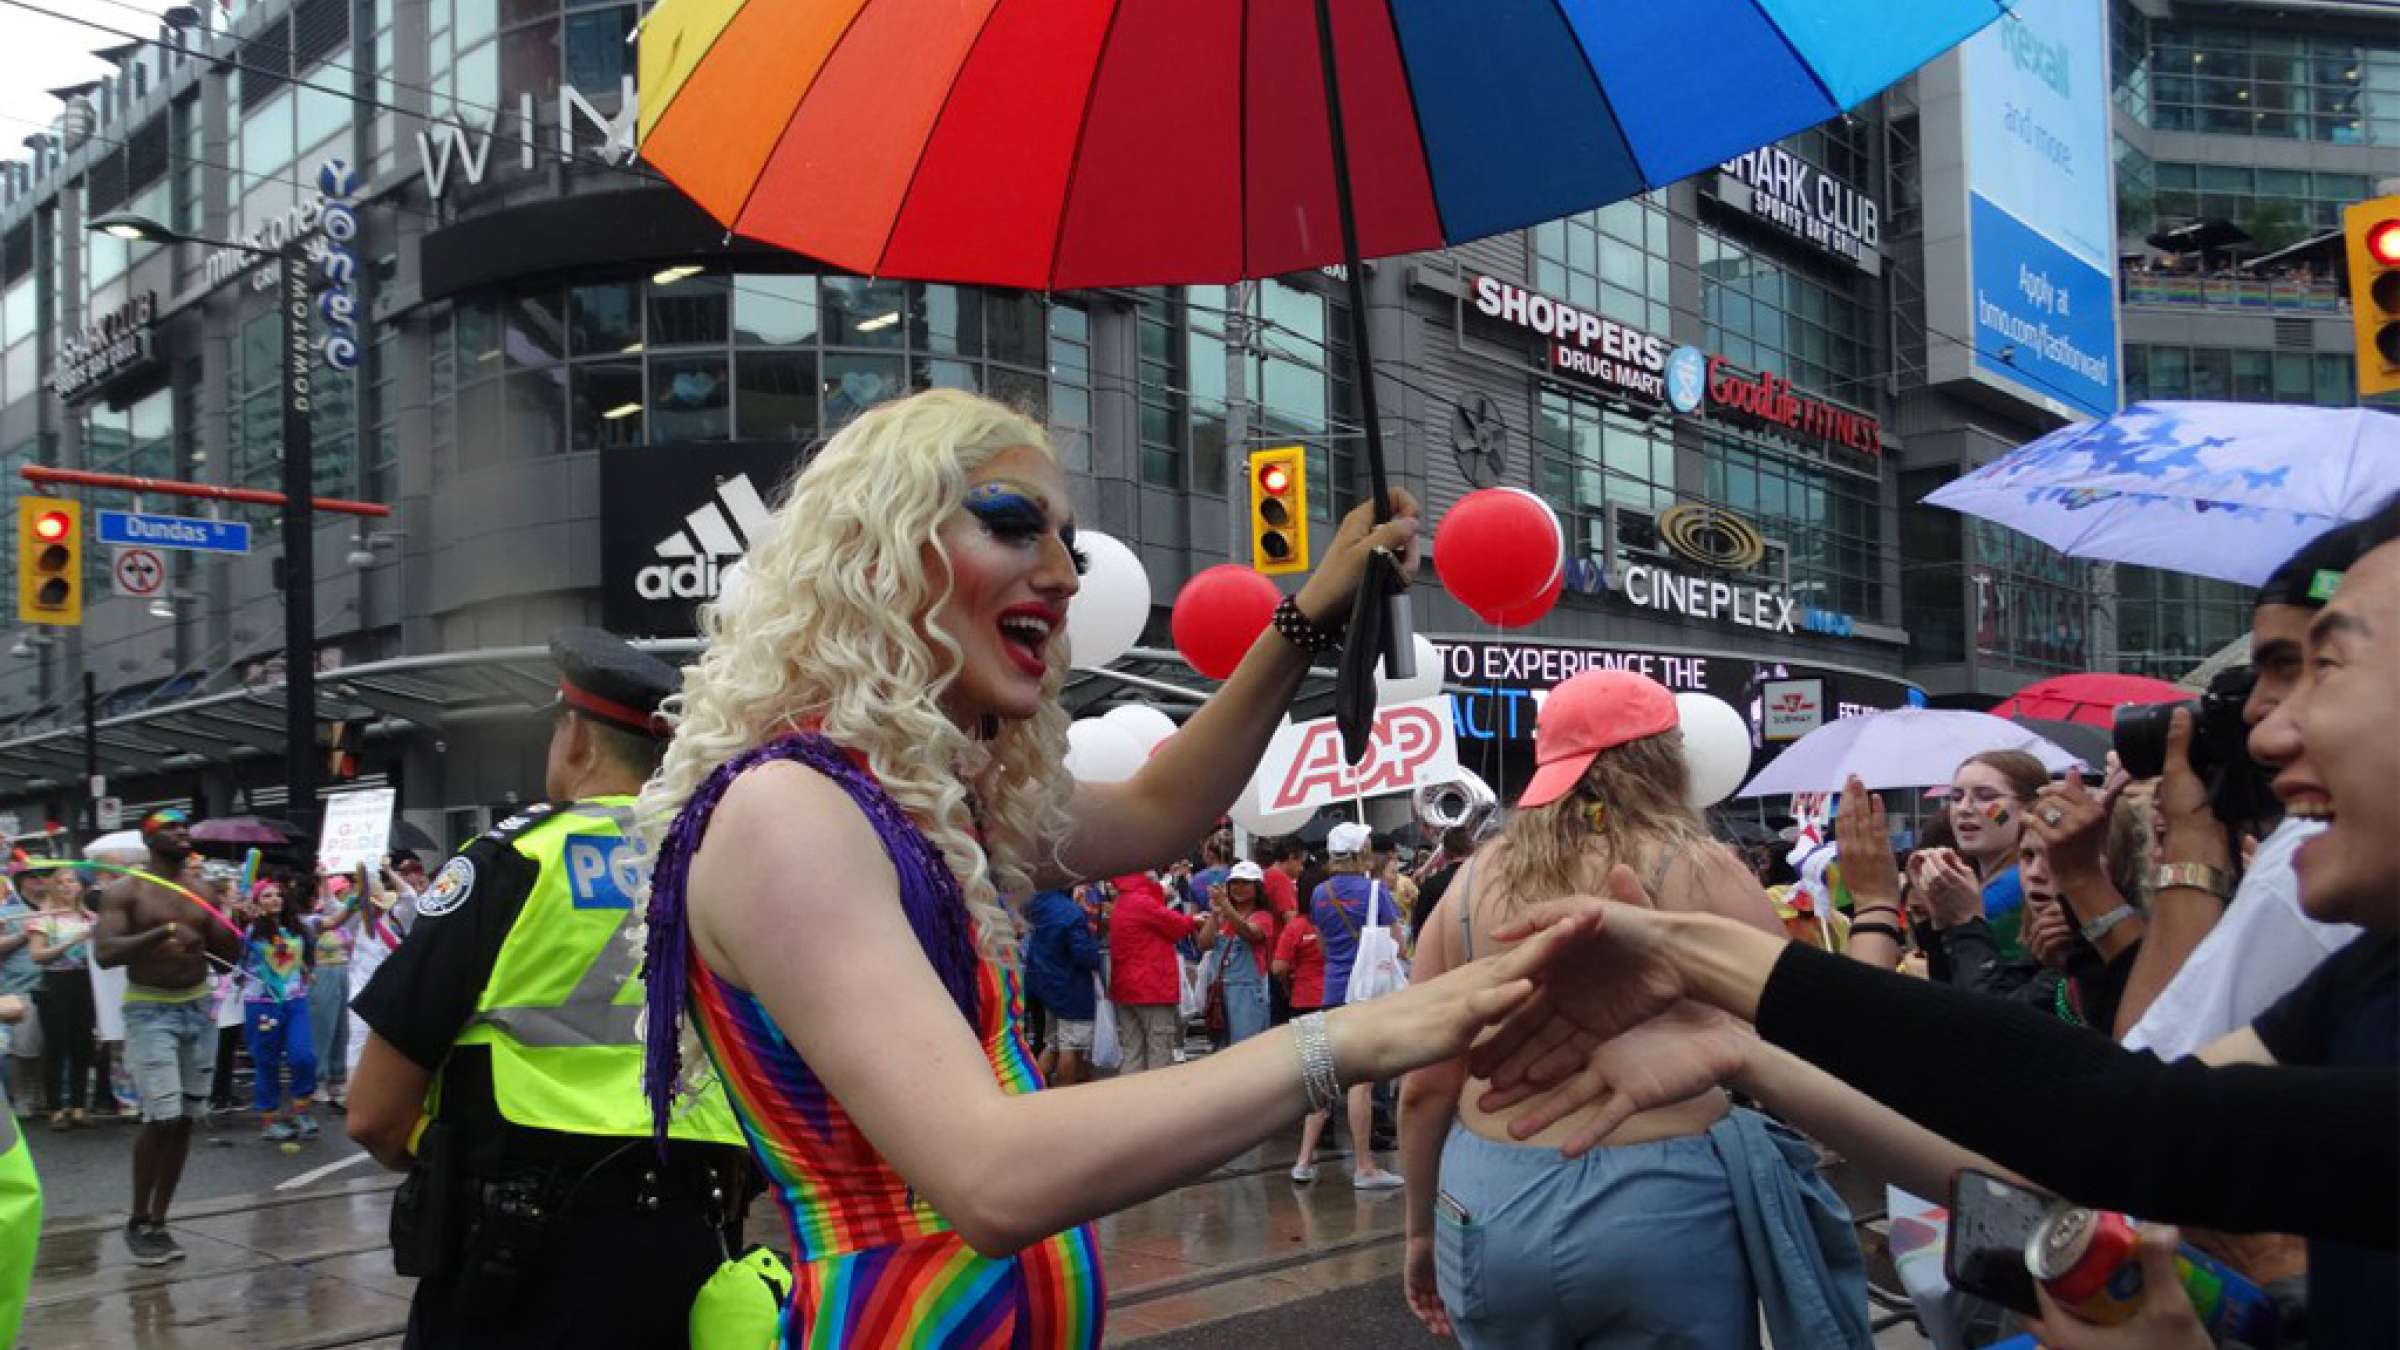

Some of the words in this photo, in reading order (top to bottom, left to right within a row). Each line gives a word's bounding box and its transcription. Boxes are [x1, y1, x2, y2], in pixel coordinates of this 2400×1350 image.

[2004, 101, 2032, 144] and
[1719, 147, 1808, 213] HARK
[1818, 175, 1878, 247] CLUB
[1473, 275, 1665, 371] SHOPPERS
[2019, 262, 2054, 315] Apply
[2057, 288, 2070, 319] at
[291, 258, 310, 411] DOWNTOWN
[1979, 288, 2109, 387] bmo.com/fastforward
[1558, 346, 1612, 379] DRUG
[1616, 365, 1664, 399] MART
[1708, 355, 1799, 429] GoodLife
[1803, 398, 1881, 457] FITNESS
[126, 516, 208, 543] Dundas
[1625, 565, 1796, 633] CINEPLEX
[1433, 644, 1474, 677] TO
[1659, 655, 1707, 689] THE
